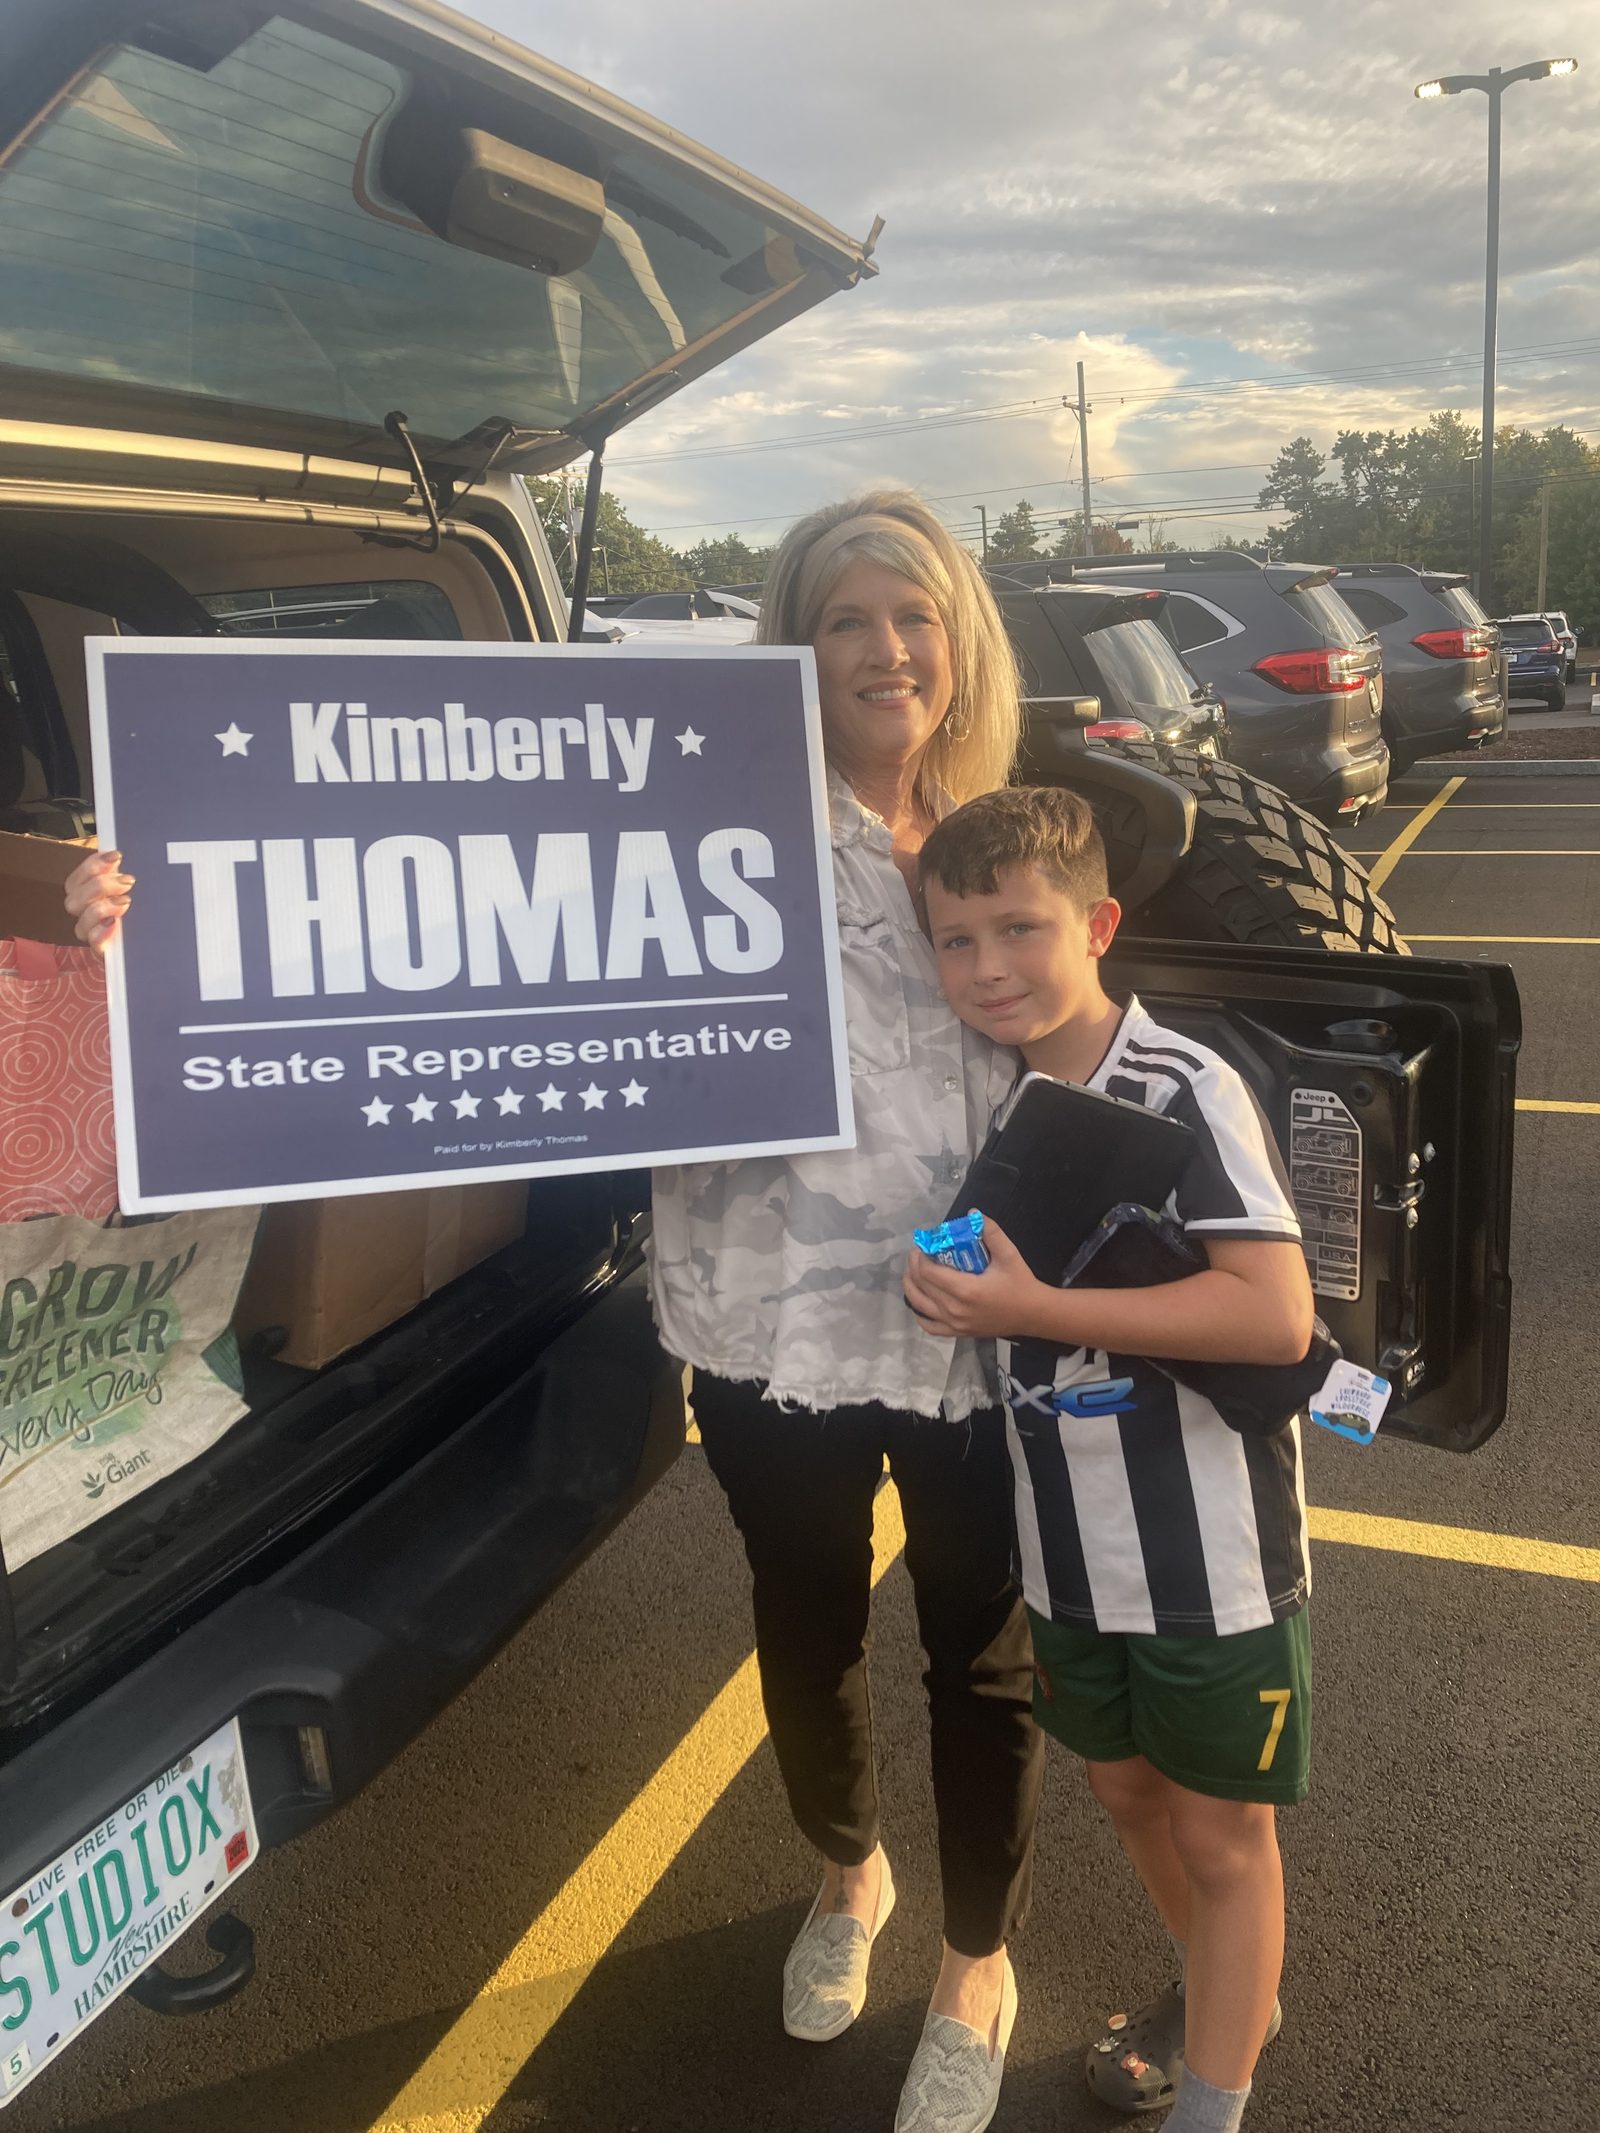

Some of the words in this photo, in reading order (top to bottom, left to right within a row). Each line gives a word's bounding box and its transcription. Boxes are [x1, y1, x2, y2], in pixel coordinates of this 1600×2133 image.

[289, 702, 654, 793] Kimberly
[166, 827, 785, 1002] THOMAS
[182, 1052, 345, 1092] State
[366, 1024, 793, 1081] Representative
[1303, 1092, 1327, 1102] Jeep
[433, 1144, 459, 1156] Paid
[461, 1142, 478, 1153] for
[479, 1141, 494, 1152] by
[495, 1137, 544, 1149] Kimberly
[545, 1134, 588, 1145] Thomas
[0, 1241, 198, 1358] GROW
[106, 1449, 151, 1484] Giant
[1257, 1689, 1291, 1771] 7
[28, 1868, 66, 1905] LIVE
[74, 1818, 118, 1865] FREE
[125, 1792, 148, 1821] OR
[155, 1763, 181, 1795] DIE
[74, 1891, 193, 2020] HAMPSHIRE
[9, 2052, 22, 2076] 5
